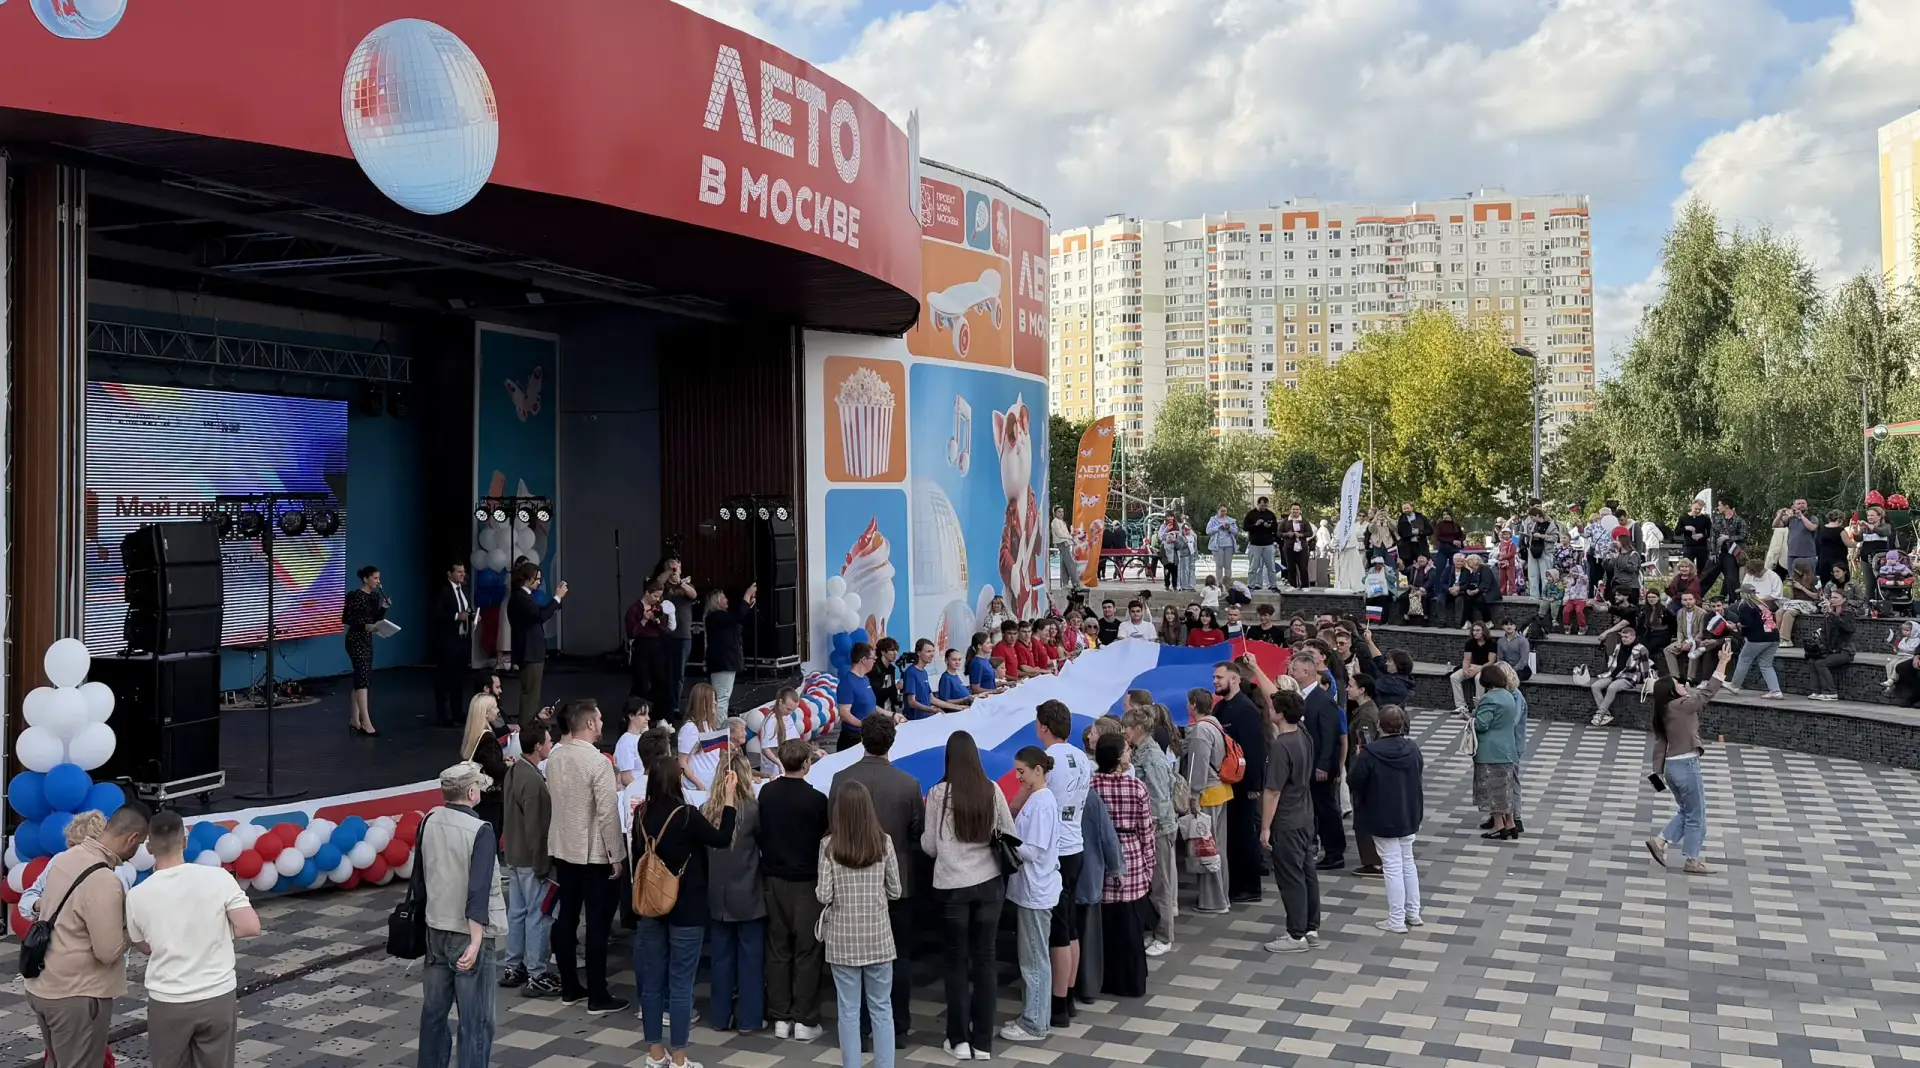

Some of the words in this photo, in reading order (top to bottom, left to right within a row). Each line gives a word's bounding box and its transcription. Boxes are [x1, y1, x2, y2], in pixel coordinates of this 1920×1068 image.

[703, 44, 861, 184] ЛЕТО
[699, 154, 727, 206] В
[740, 166, 861, 250] МОСКВЕ
[936, 191, 956, 205] ПРОЕКТ
[936, 213, 959, 226] МОСКВЫ
[1019, 250, 1048, 305] ЛЕ
[1079, 464, 1109, 473] ЛЕТО
[116, 496, 169, 516] Мой
